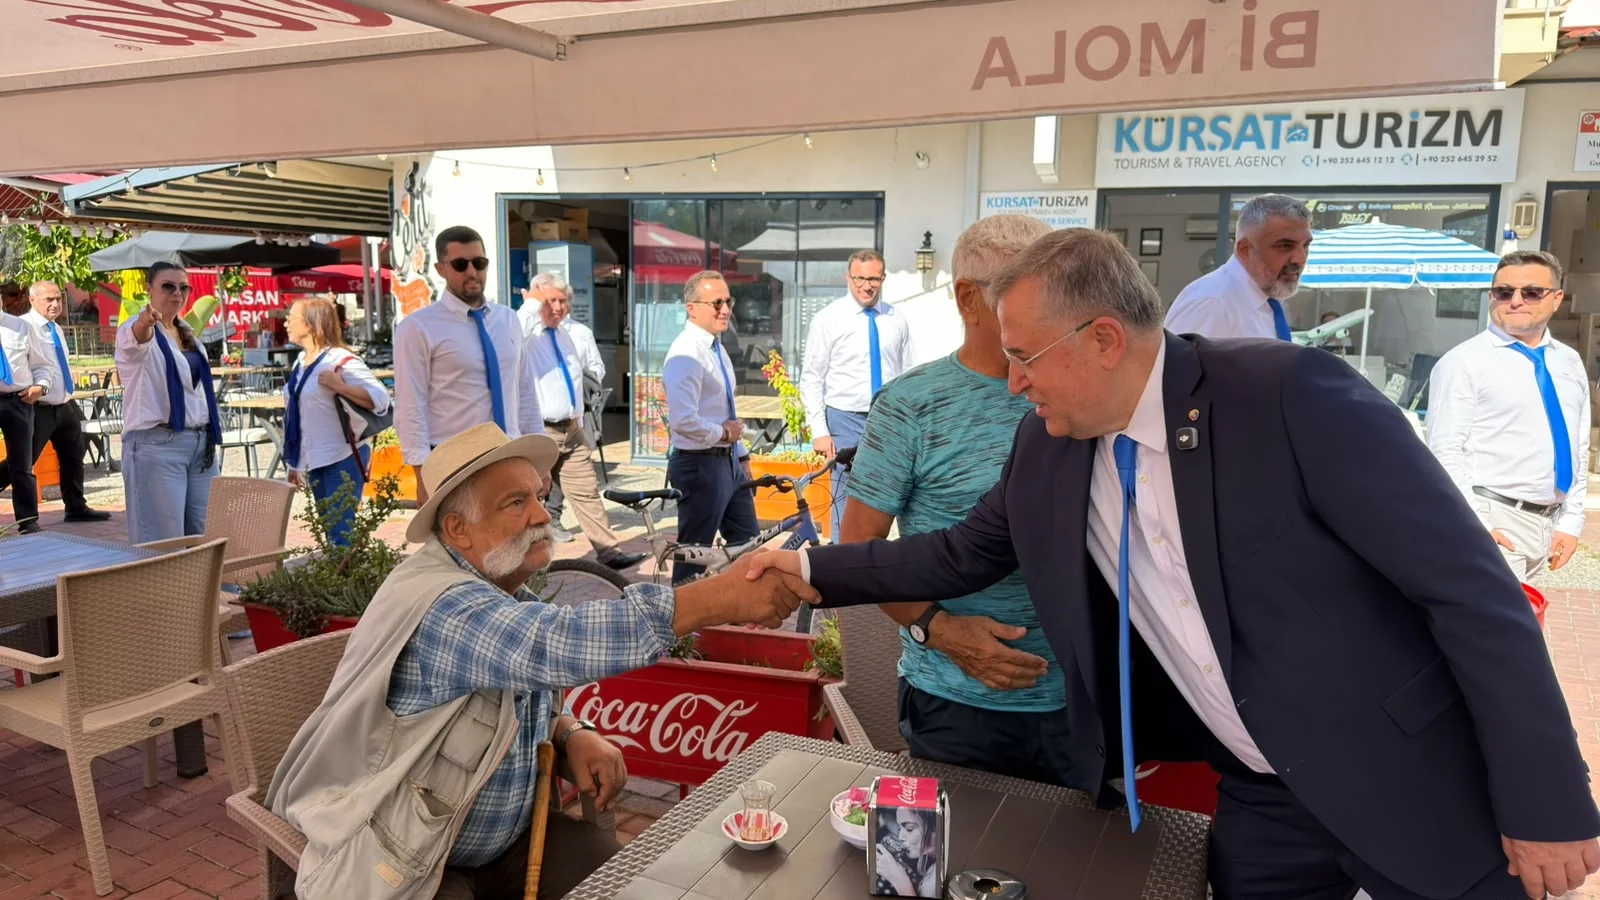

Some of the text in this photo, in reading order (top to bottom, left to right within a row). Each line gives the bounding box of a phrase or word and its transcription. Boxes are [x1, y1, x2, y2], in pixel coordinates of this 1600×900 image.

[1114, 155, 1287, 170] TOURISM & TRAVEL AGENCY
[1322, 156, 1395, 164] +90 252 645 12 12
[1422, 154, 1498, 163] +90 252 645 29 52
